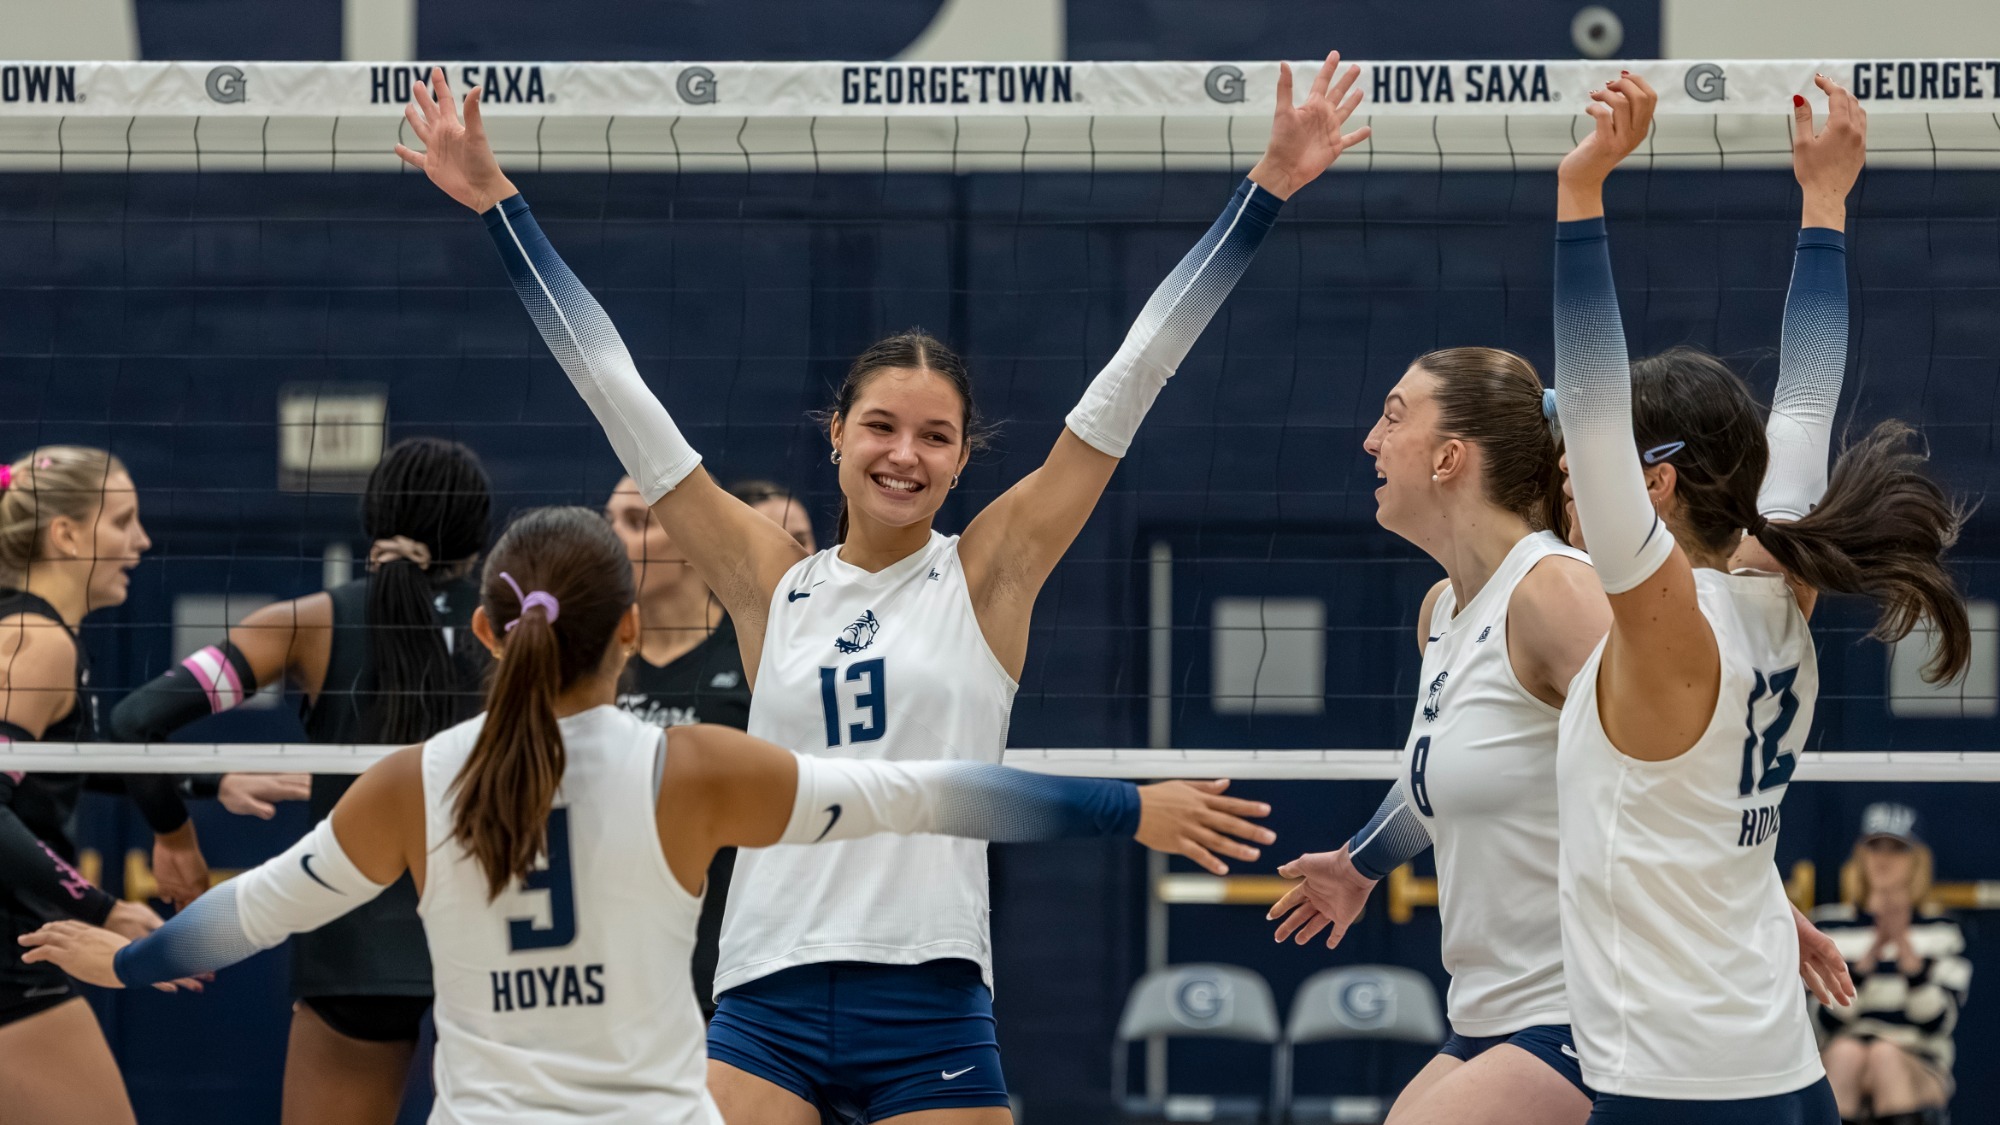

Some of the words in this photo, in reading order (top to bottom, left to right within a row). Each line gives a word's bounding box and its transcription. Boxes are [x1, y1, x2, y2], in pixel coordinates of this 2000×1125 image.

[2, 66, 75, 103] OWN
[462, 66, 546, 104] SAXA
[842, 66, 1072, 104] GEORGETOWN
[1372, 65, 1454, 103] HOYA
[1465, 64, 1550, 102] SAXA
[818, 656, 888, 749] 13
[1738, 662, 1800, 799] 12
[1411, 735, 1434, 818] 8
[491, 964, 605, 1012] HOYAS
